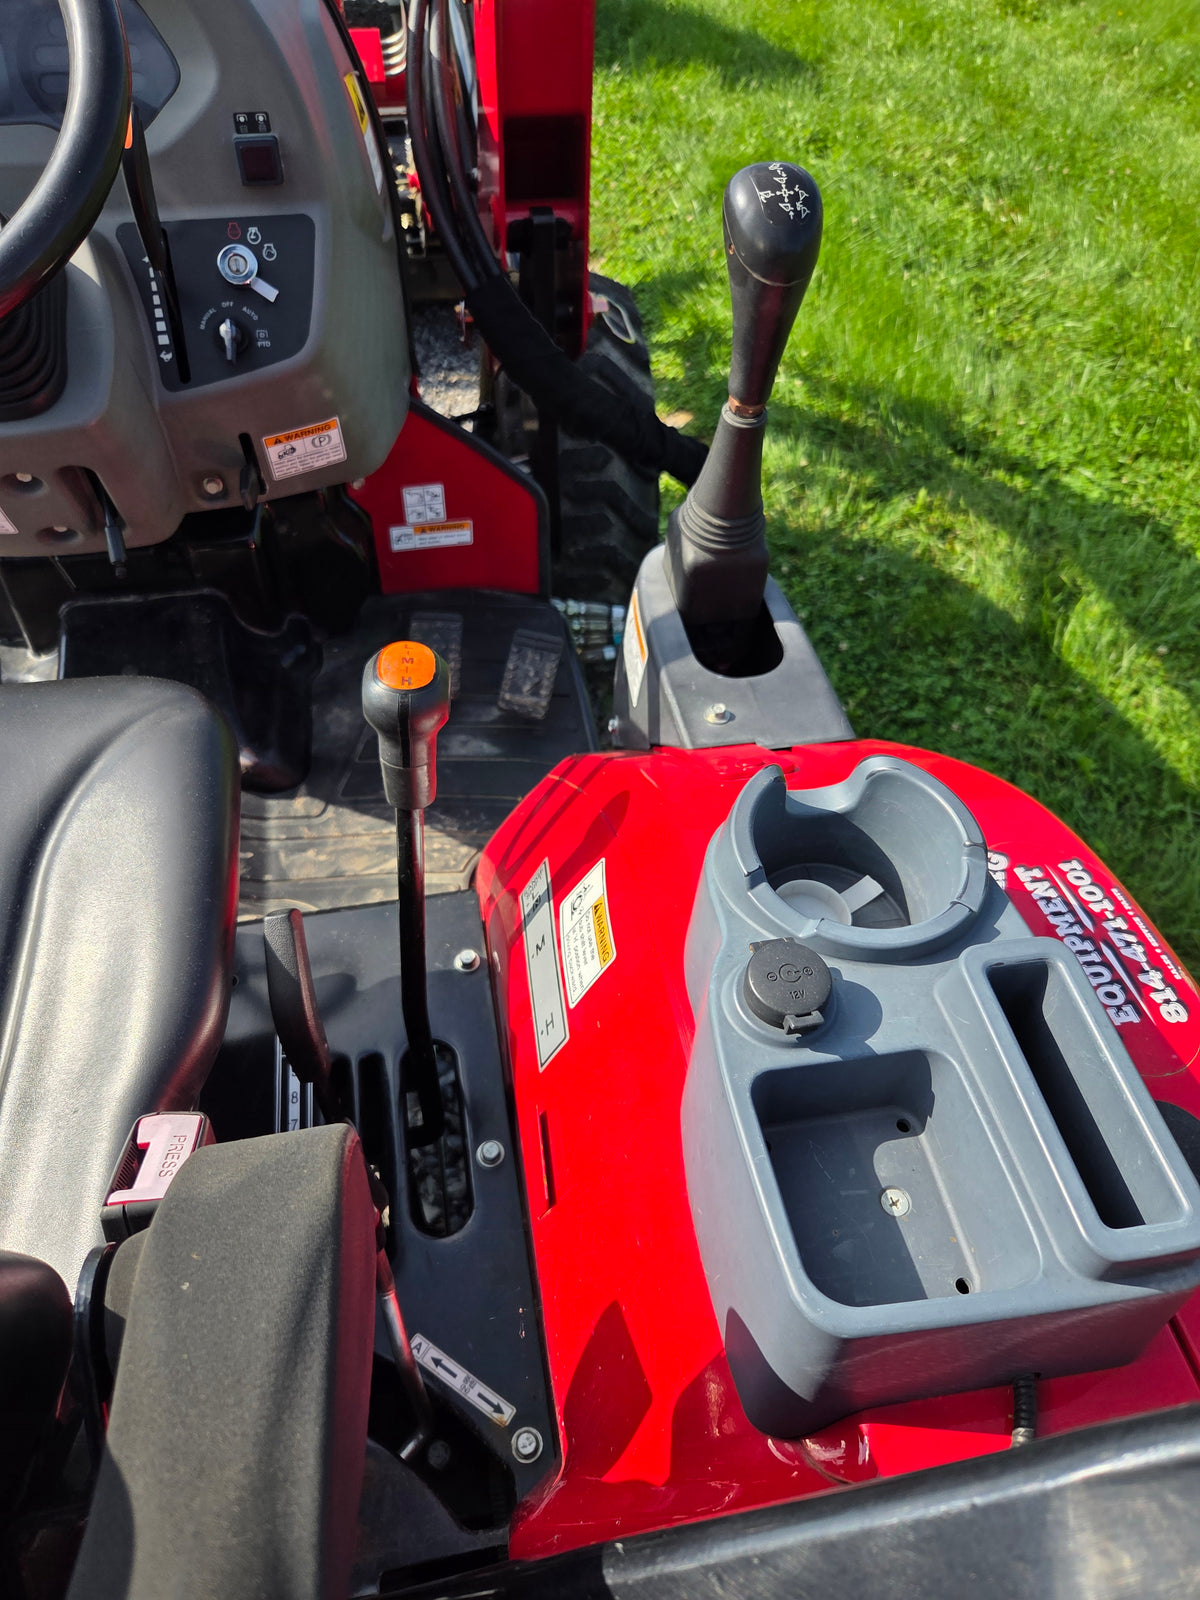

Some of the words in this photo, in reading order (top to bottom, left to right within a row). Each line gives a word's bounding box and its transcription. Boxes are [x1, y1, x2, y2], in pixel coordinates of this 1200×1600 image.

[200, 307, 217, 330] MANUAL
[242, 306, 258, 320] AUTO
[284, 424, 331, 442] WARNING
[401, 676, 412, 686] H
[535, 934, 546, 958] M
[596, 914, 610, 962] WARNING
[1013, 865, 1141, 1026] EQUIPMENT
[1057, 857, 1189, 1024] 814-471-1001
[789, 989, 806, 1000] 12V
[545, 1012, 555, 1036] H
[291, 1090, 298, 1104] 8
[290, 1119, 298, 1131] 7
[158, 1135, 187, 1178] PRESS
[412, 1342, 422, 1355] A
